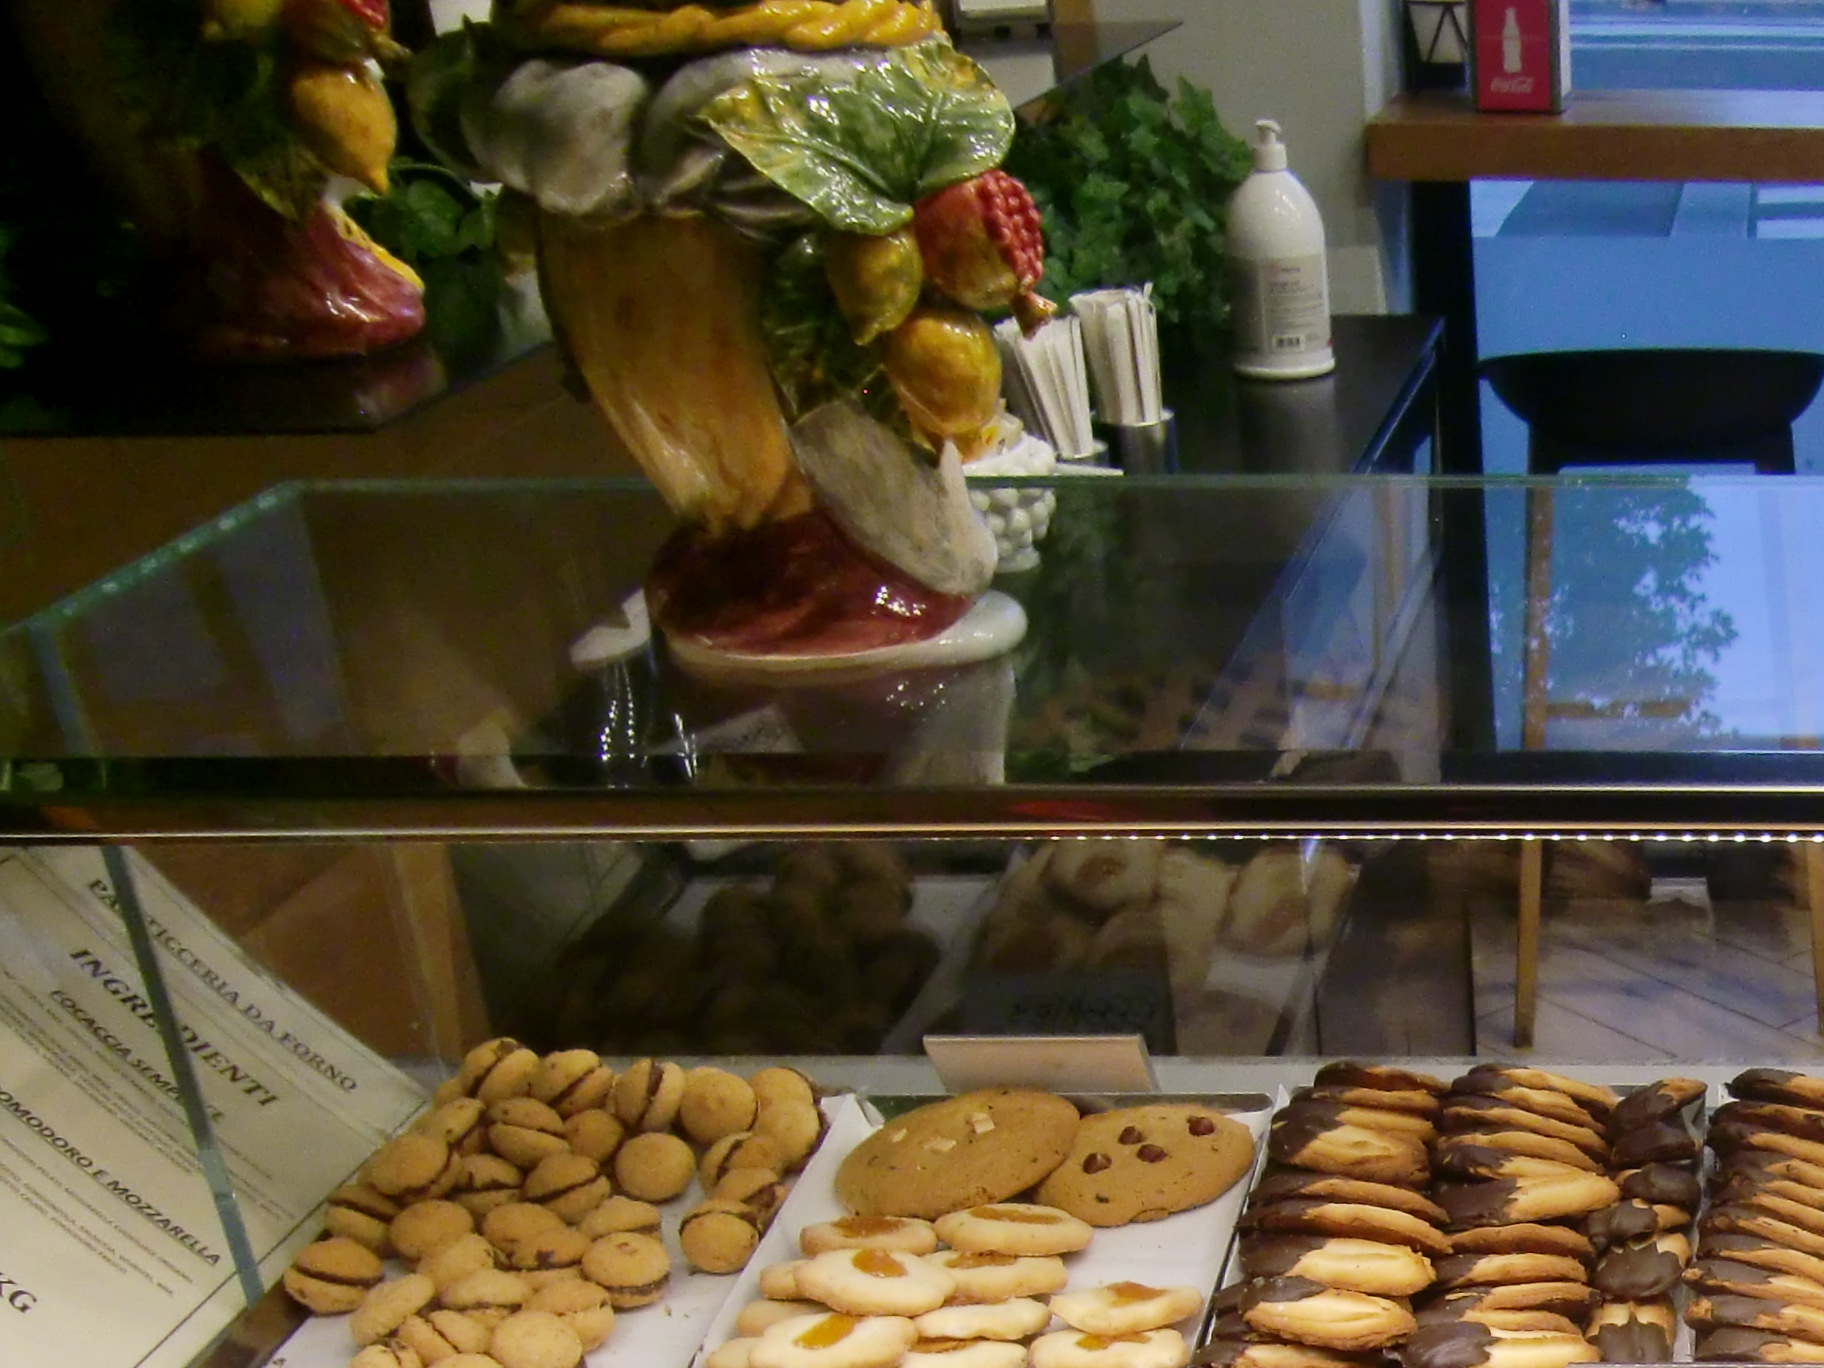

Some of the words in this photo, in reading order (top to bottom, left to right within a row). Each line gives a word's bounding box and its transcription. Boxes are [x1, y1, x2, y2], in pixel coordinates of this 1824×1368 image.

[51, 989, 132, 1060] FOCACCIA
[88, 878, 241, 1008] PATICCERIA
[244, 1003, 276, 1034] DA
[276, 1031, 358, 1093] FORNO
[106, 1178, 221, 1267] MOZZARELLA
